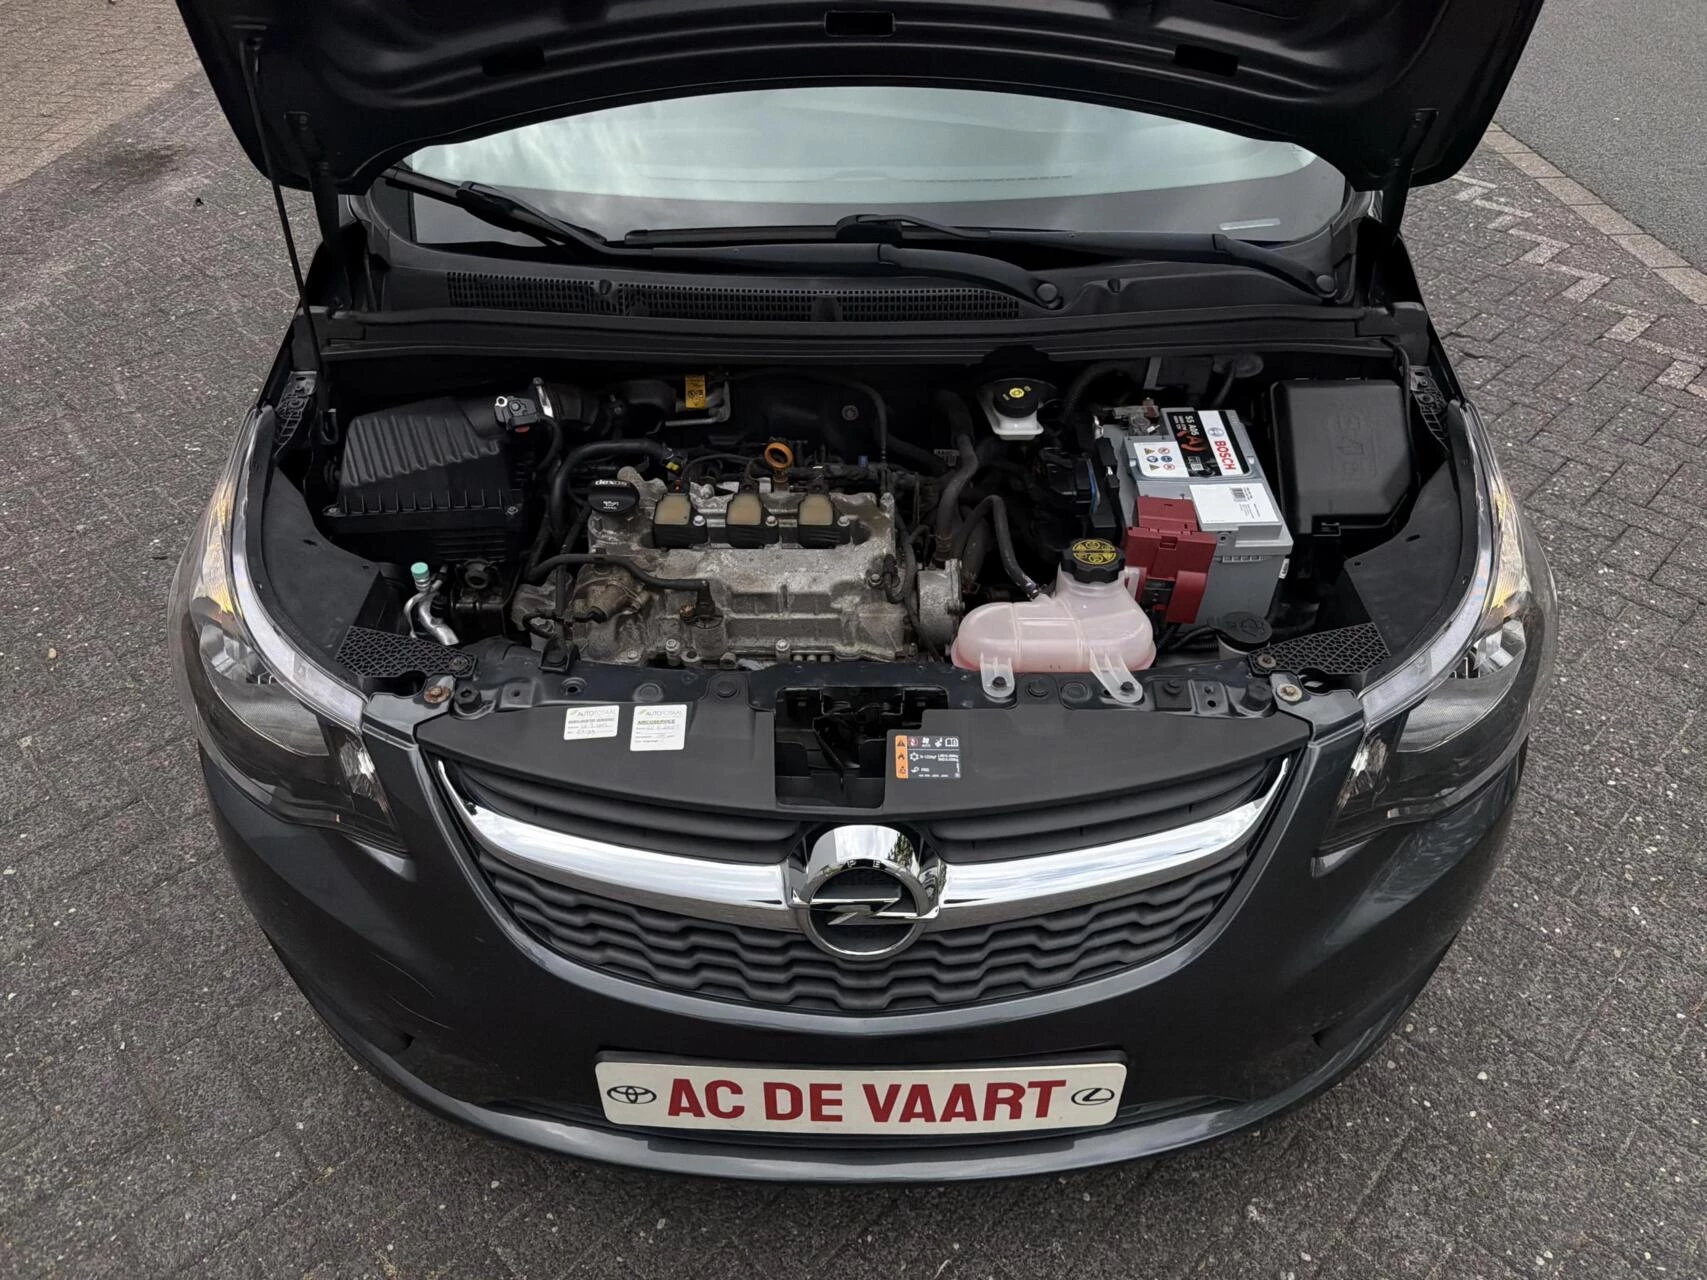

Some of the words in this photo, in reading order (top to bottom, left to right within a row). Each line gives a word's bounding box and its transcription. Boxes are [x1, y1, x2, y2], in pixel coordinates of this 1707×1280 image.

[1214, 440, 1237, 470] BOSCH
[668, 1079, 744, 1119] AC
[763, 1082, 843, 1122] DE
[863, 1080, 1066, 1122] VAART
